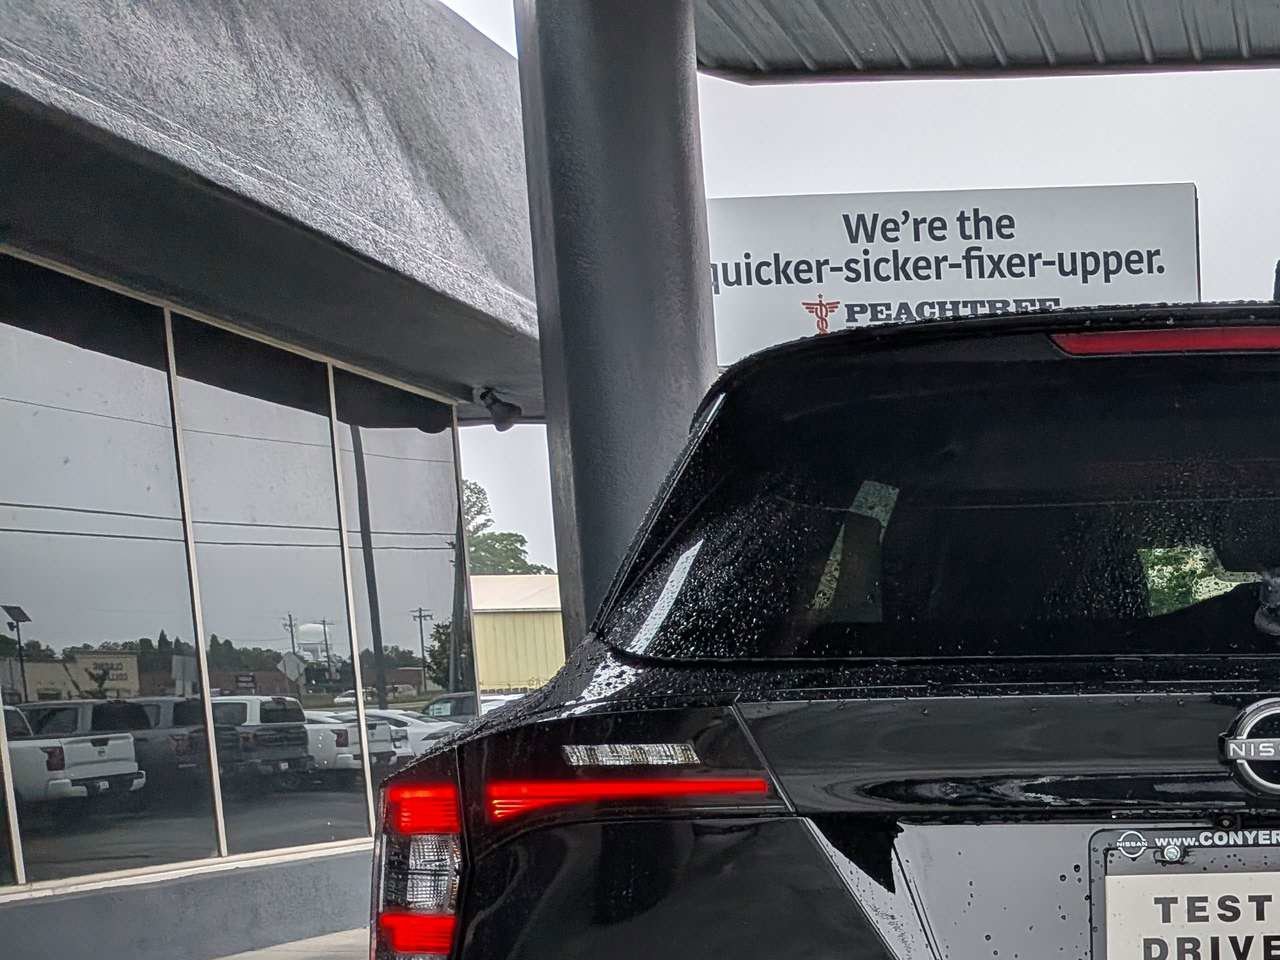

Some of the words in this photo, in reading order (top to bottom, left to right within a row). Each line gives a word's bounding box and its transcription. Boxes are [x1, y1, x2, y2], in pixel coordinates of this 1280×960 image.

[842, 210, 947, 244] We're
[956, 207, 1016, 241] the
[1116, 840, 1148, 848] NISSAN
[1153, 893, 1273, 924] TEST
